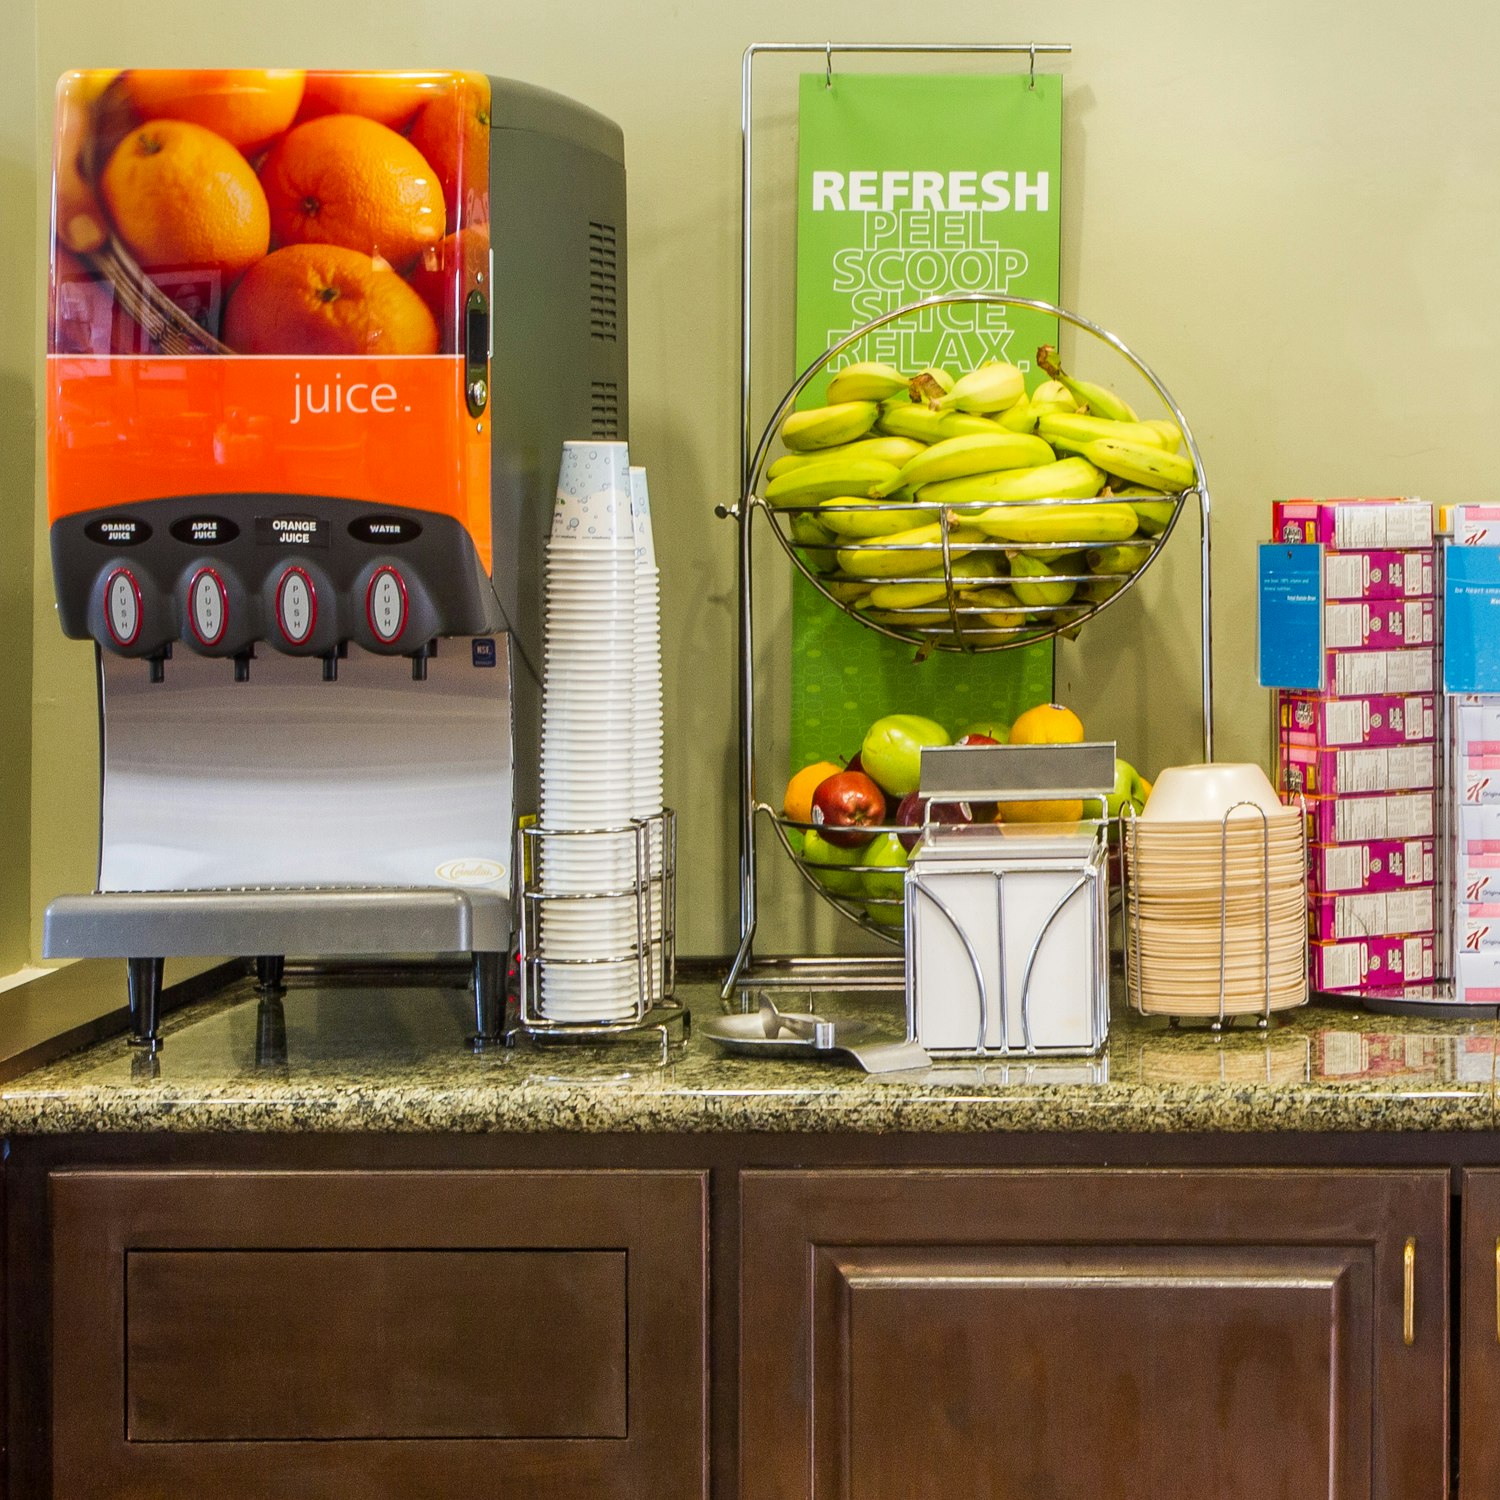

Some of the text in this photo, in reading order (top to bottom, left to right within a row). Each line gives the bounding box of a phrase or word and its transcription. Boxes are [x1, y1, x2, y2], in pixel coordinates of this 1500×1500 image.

[812, 170, 1049, 211] REFRESH
[864, 208, 999, 251] PEEL
[833, 247, 1029, 292] SCOOP
[851, 288, 1009, 333] SLICE
[826, 329, 1031, 373] RELAX.
[290, 372, 411, 424] juice.
[101, 523, 136, 532] ORANGE
[108, 532, 131, 540] JUICE
[191, 522, 218, 531] APPLE
[193, 531, 217, 539] JUICE
[272, 520, 317, 532] ORANGE
[279, 532, 310, 543] JUICE
[369, 524, 401, 533] WATER
[119, 586, 128, 630] PUSH
[205, 585, 213, 629] PUSH
